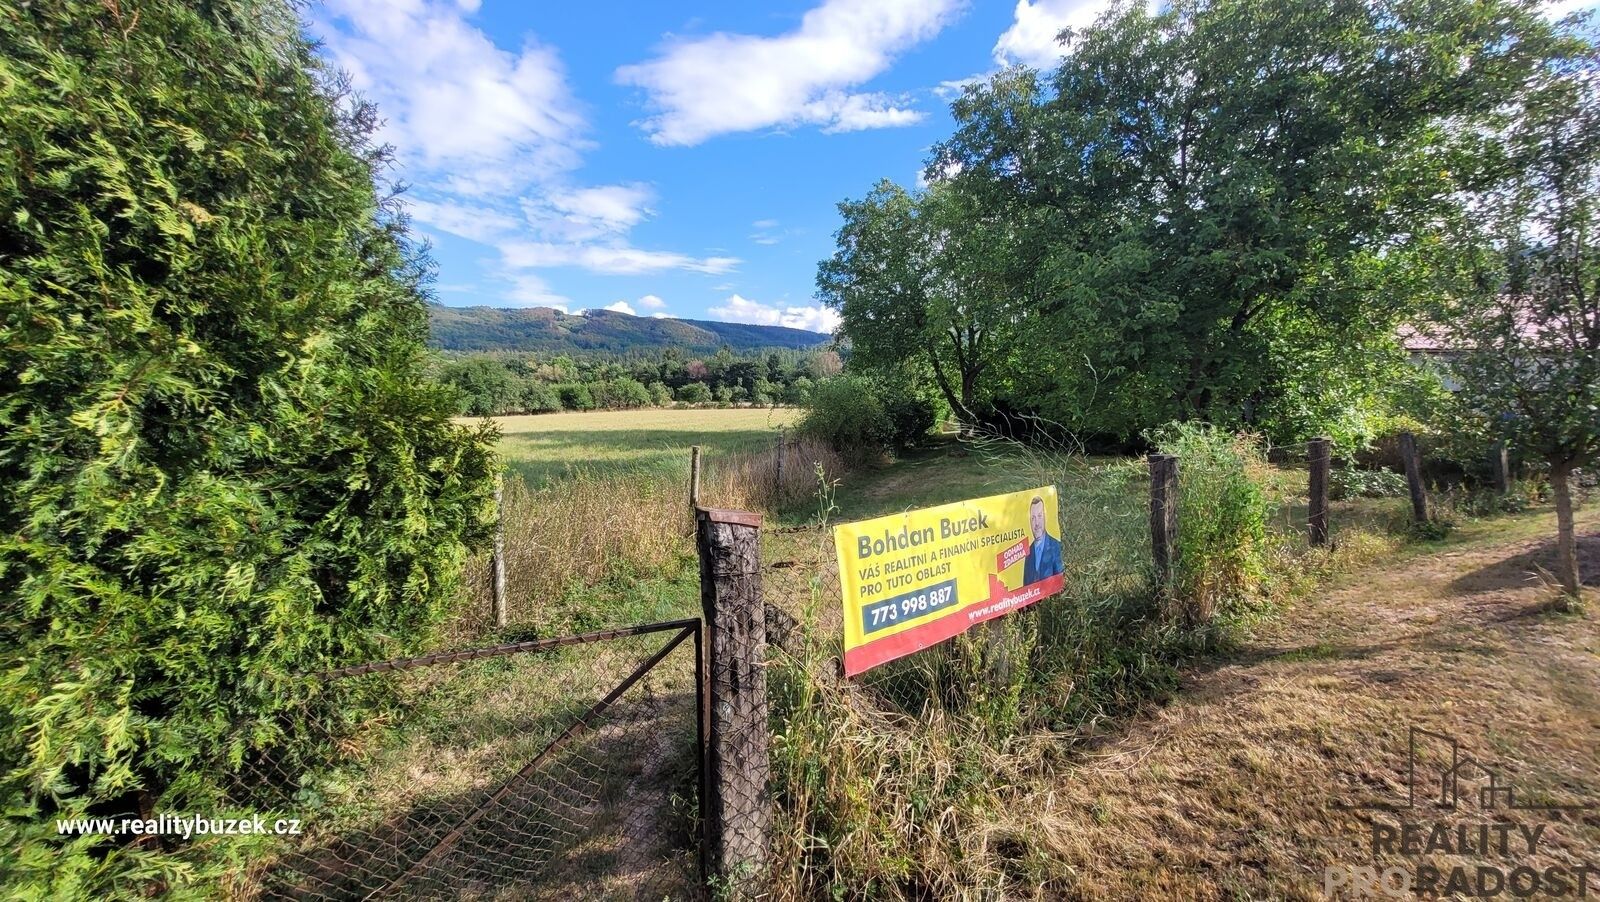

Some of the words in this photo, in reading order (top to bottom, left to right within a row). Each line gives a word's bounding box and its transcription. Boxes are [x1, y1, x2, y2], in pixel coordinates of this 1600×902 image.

[858, 526, 934, 559] Bohdan
[941, 510, 989, 539] Buzek
[1003, 542, 1024, 559] ODHAD
[859, 562, 881, 581] VÁŠ
[884, 550, 927, 575] REALITNÍ
[930, 551, 938, 563] A
[939, 536, 979, 559] FINANČNÍ
[981, 528, 1026, 547] SPECIALISTA
[1003, 550, 1027, 568] ZDARMA
[860, 582, 883, 598] PRO
[886, 573, 913, 590] TUTO
[916, 562, 951, 581] OBLAST
[871, 605, 898, 626] 773
[902, 594, 928, 615] 998
[930, 586, 952, 607] 887
[968, 588, 1041, 620] www.realitybuzek.cz
